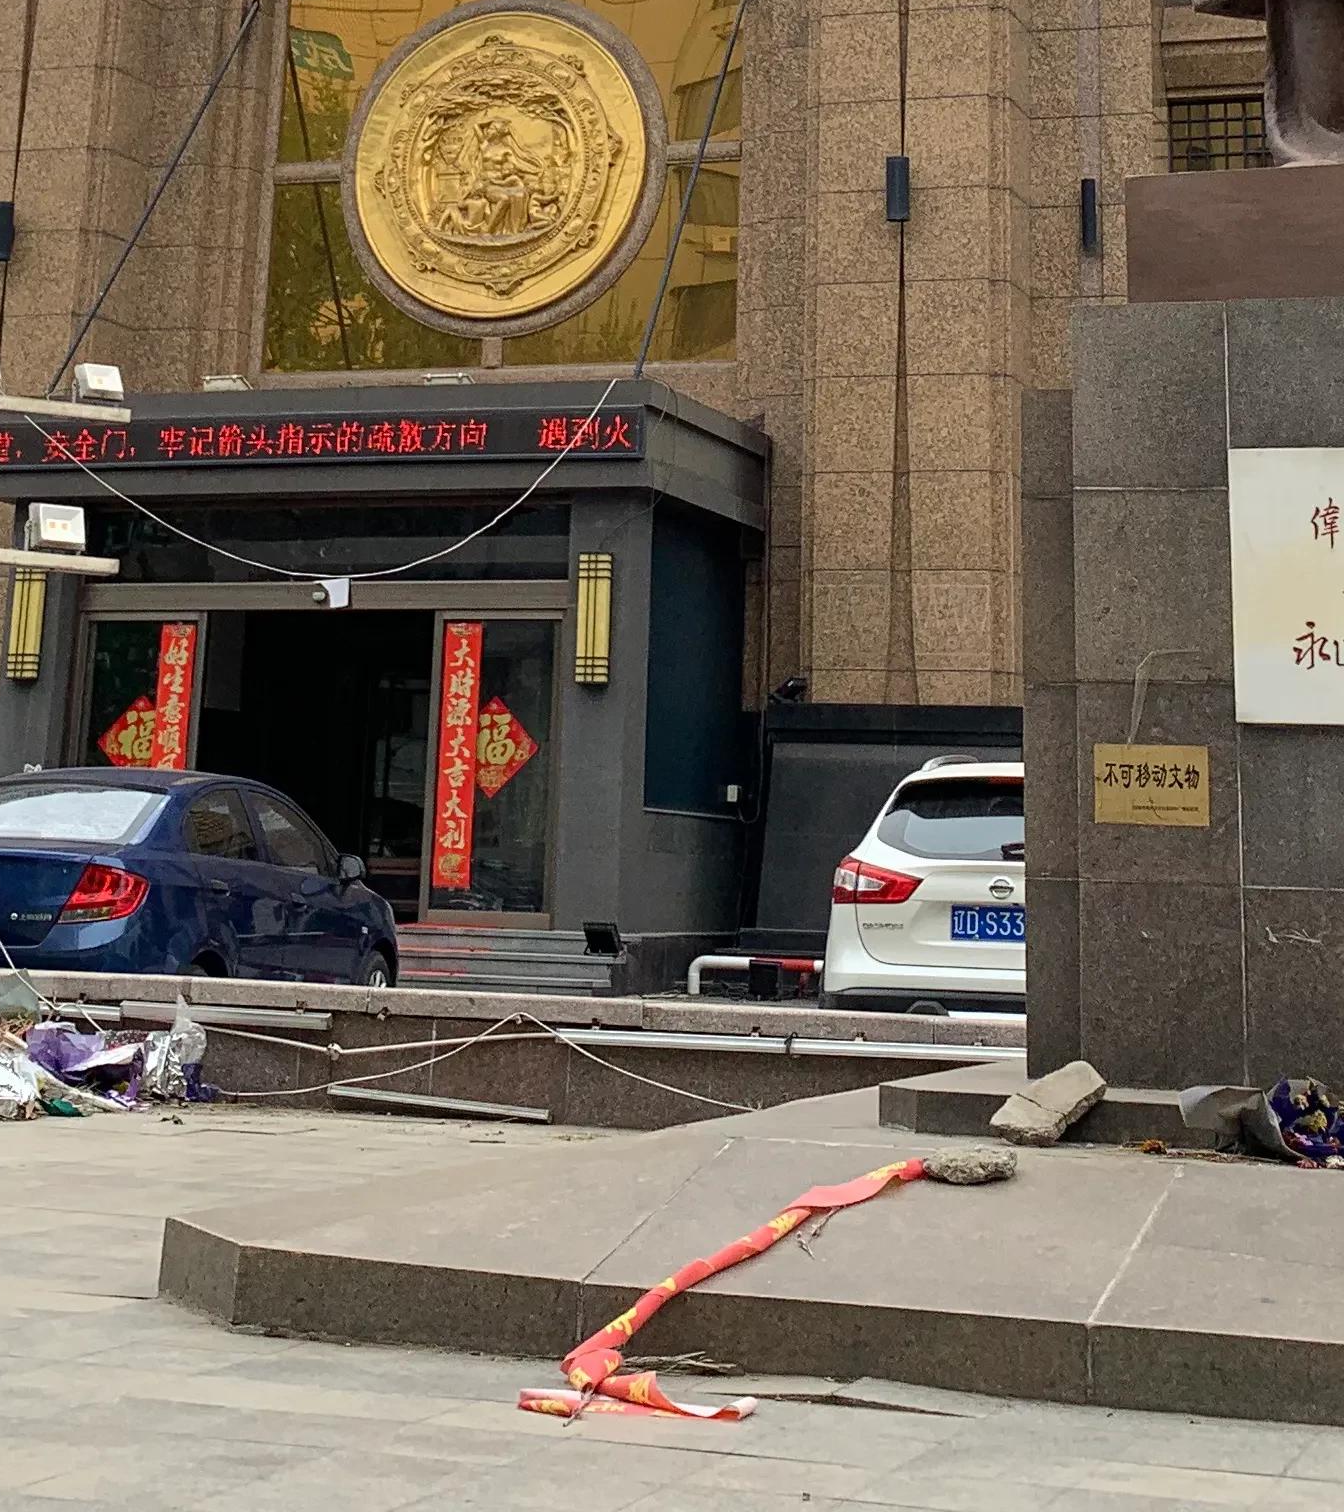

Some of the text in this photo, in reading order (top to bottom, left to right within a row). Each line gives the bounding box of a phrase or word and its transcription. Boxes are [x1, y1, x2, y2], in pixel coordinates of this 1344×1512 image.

[537, 413, 634, 451] 遇到火
[118, 710, 157, 760] 福
[476, 713, 516, 766] 福
[1103, 762, 1200, 790] 不可移动文物
